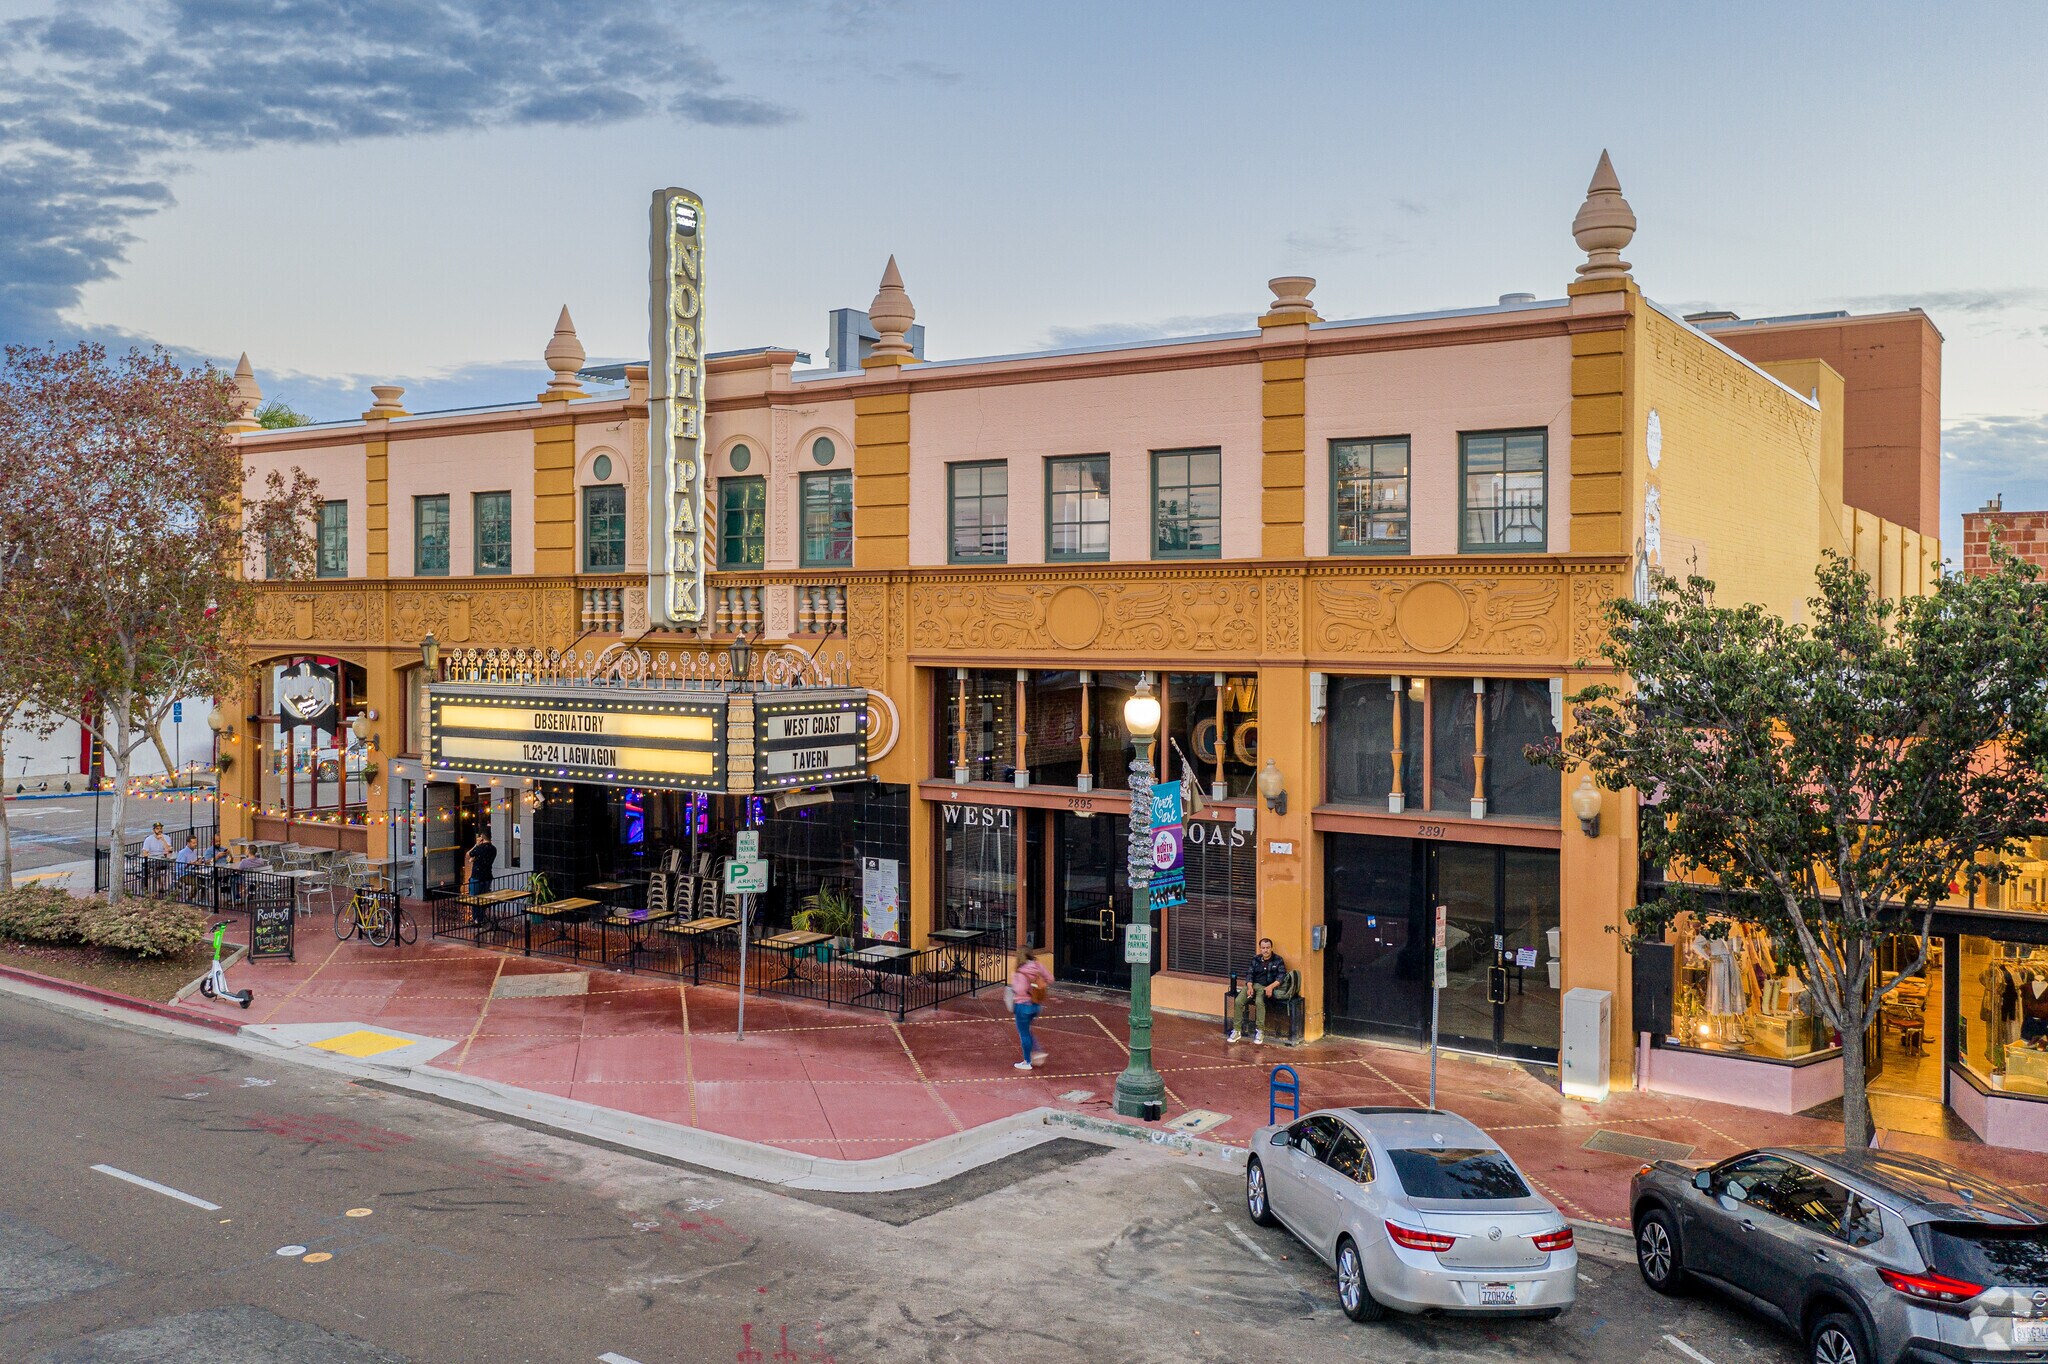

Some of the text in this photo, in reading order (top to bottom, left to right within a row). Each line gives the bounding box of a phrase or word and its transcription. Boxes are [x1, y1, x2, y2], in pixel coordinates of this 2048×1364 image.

[674, 241, 699, 439] NORTH
[674, 458, 698, 612] PARK
[534, 713, 604, 733] OBSERVATORY
[784, 715, 841, 737] WEST COAST
[523, 744, 617, 767] 11.23-24 LAGWAGON
[792, 750, 829, 770] TAVERN
[1067, 798, 1093, 809] 2895
[1152, 794, 1175, 811] North
[942, 804, 1012, 828] WEST
[1158, 807, 1178, 824] Park
[1418, 825, 1446, 838] 2891
[1156, 841, 1173, 855] NORTH
[1156, 852, 1171, 864] PARK
[1127, 941, 1149, 949] PARKING
[1129, 933, 1148, 941] MINUTE
